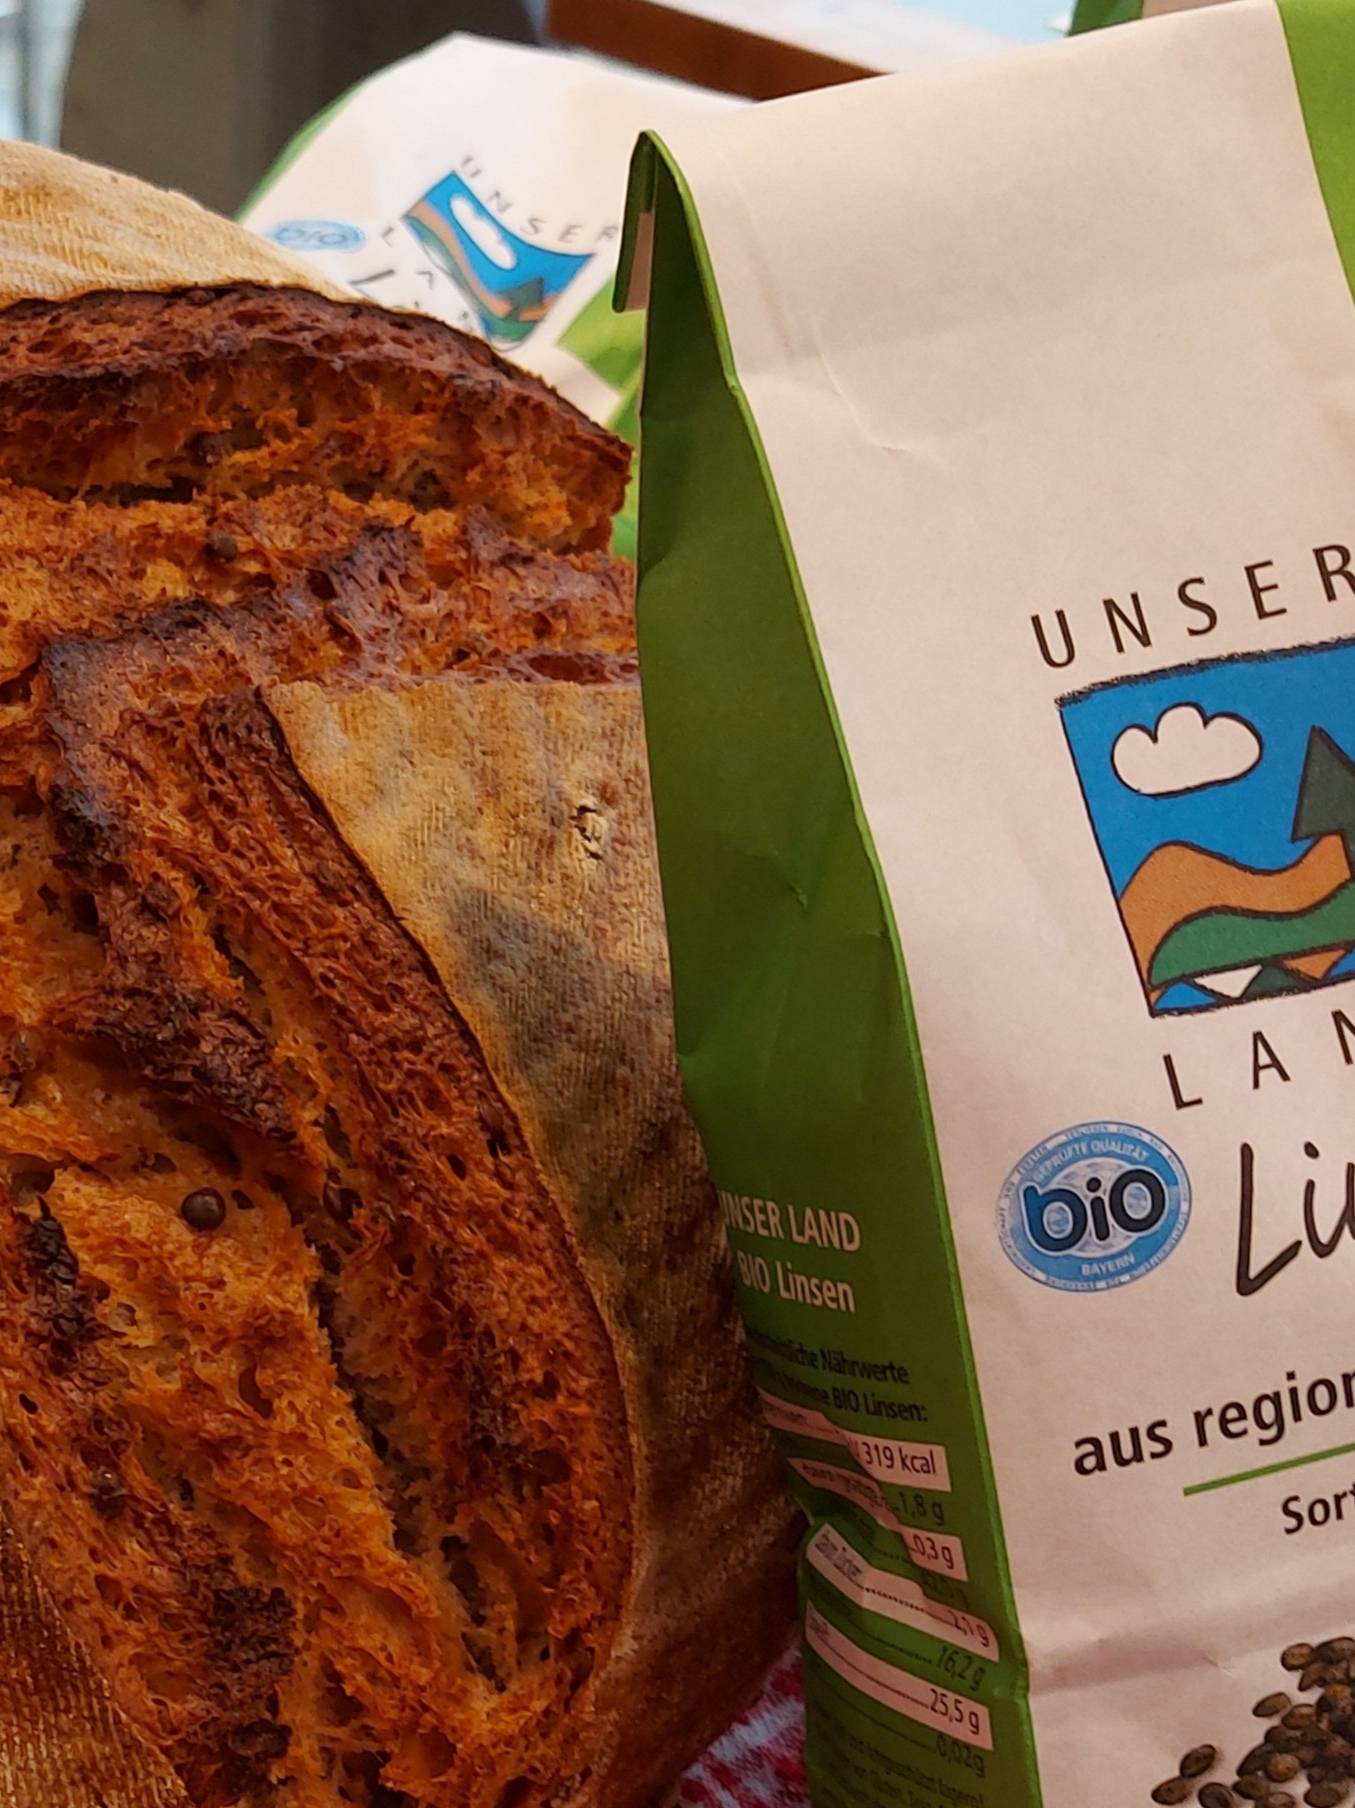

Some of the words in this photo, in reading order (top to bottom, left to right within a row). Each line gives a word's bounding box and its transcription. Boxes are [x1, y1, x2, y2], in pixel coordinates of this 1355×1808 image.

[1030, 543, 1355, 668] UNSER
[786, 1203, 861, 1253] LAND
[1023, 1168, 1166, 1252] bio
[736, 1249, 771, 1295] BIO
[775, 1259, 857, 1315] Linsen
[1081, 1252, 1137, 1277] BAYERN
[821, 1347, 911, 1385] Nährwerte
[832, 1386, 861, 1414] BIO
[864, 1393, 929, 1423] Linsen:
[861, 1441, 895, 1469] 319
[900, 1448, 937, 1475] kcal
[1072, 1417, 1174, 1477] aus
[932, 1501, 946, 1527] g
[940, 1545, 956, 1571] g
[970, 1666, 987, 1692] g
[928, 1687, 965, 1724] 25,5
[968, 1711, 982, 1736] g
